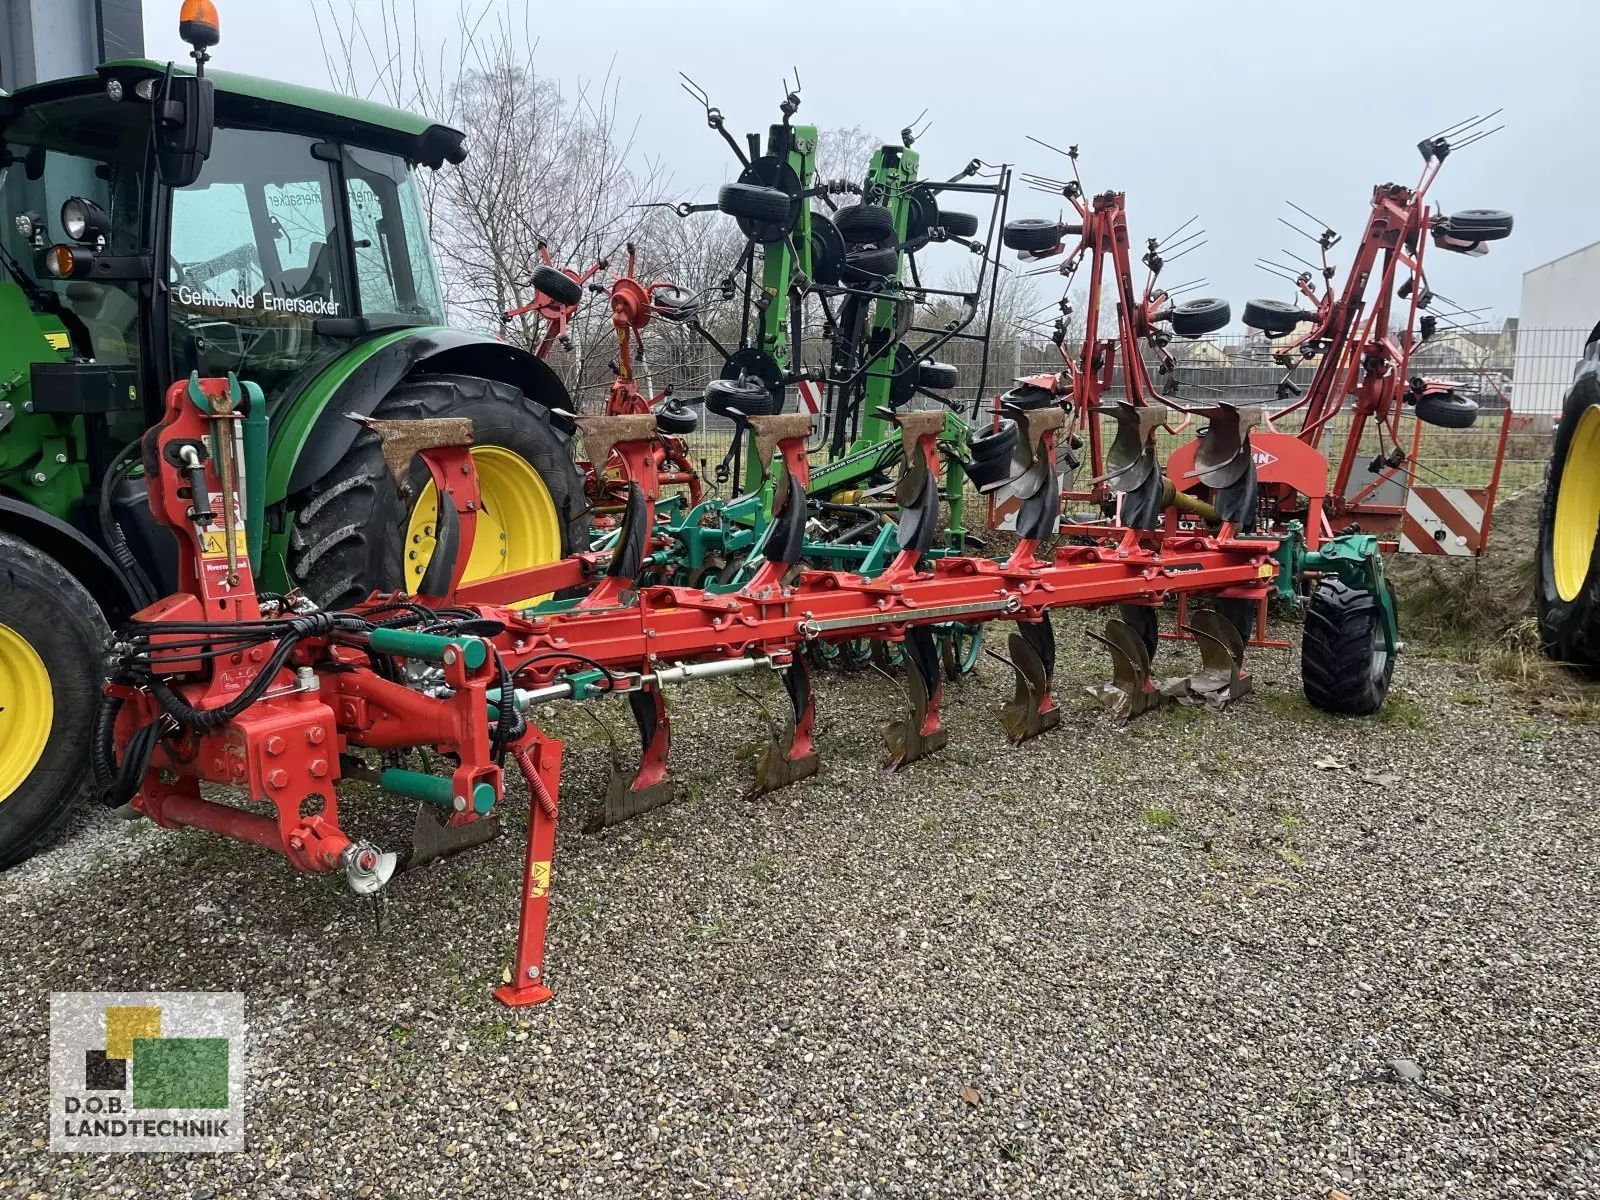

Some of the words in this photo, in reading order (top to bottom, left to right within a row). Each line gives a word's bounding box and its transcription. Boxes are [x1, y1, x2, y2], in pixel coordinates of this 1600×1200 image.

[178, 286, 255, 309] Gemeinde
[262, 292, 340, 315] Emersacker
[206, 561, 247, 572] Kvernnd
